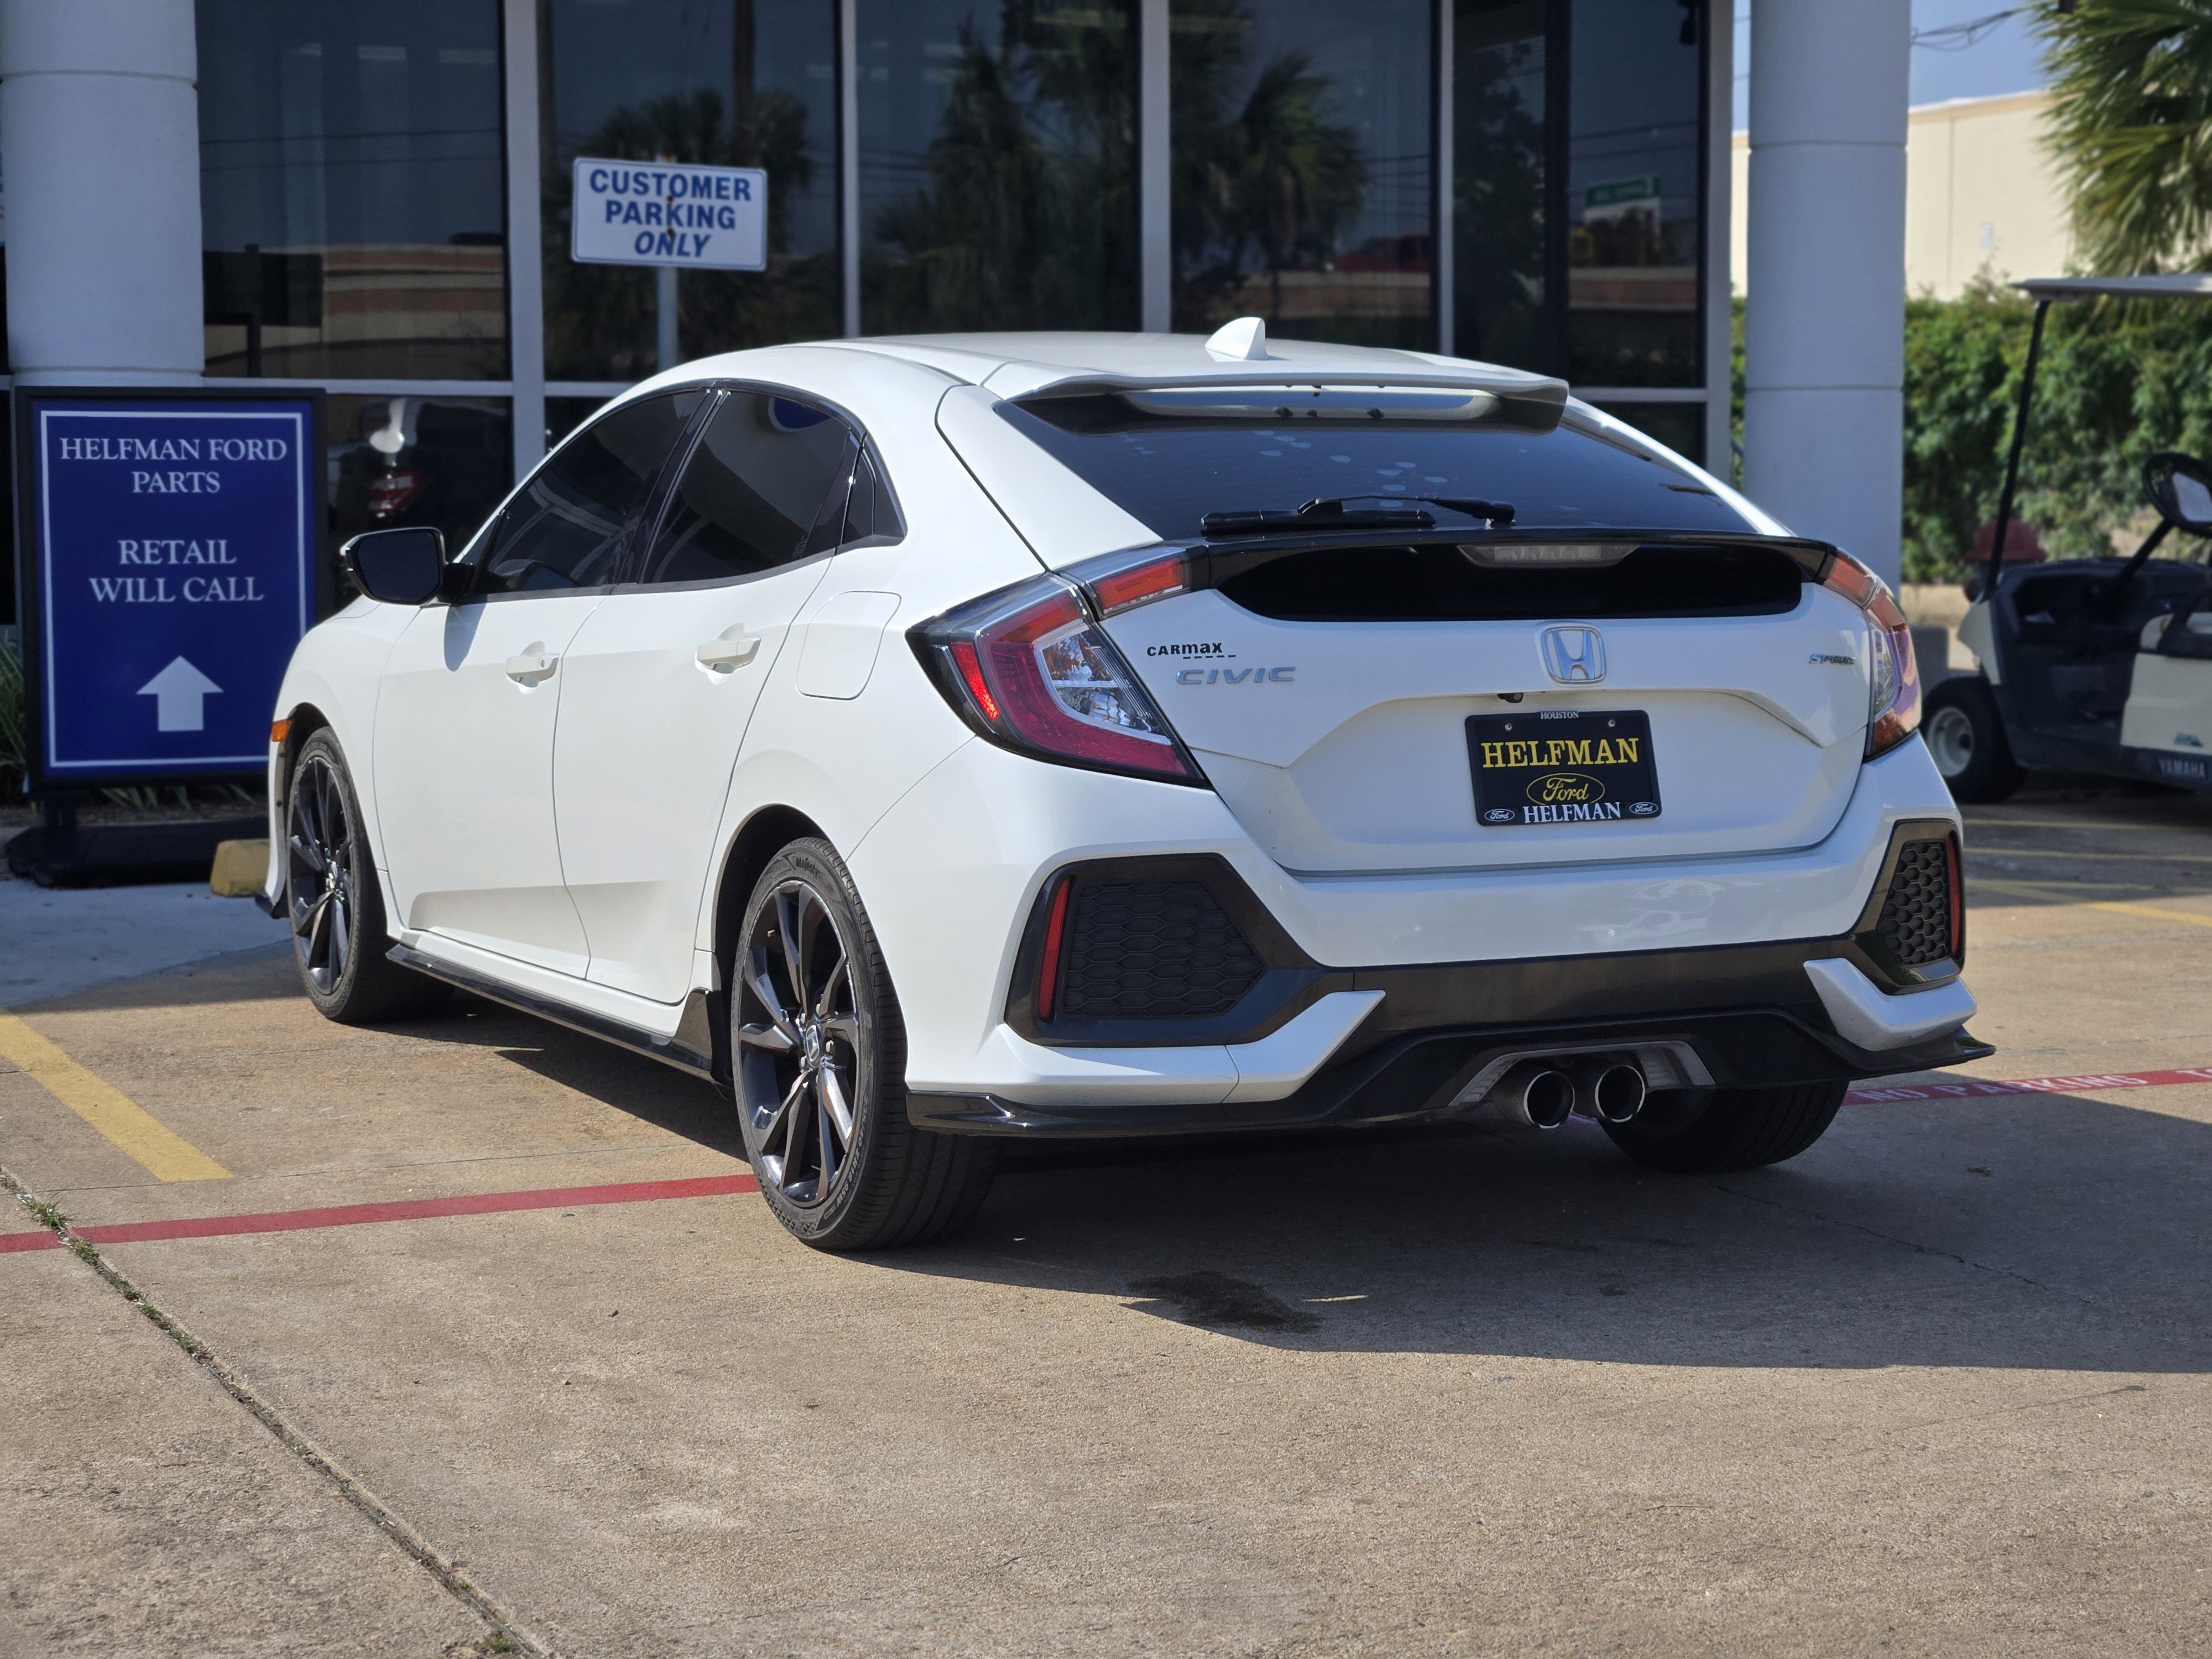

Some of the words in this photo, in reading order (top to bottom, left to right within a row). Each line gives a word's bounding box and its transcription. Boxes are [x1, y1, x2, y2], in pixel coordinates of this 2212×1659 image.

[589, 169, 751, 201] CUSTOMER
[606, 200, 735, 229] PARKING
[634, 231, 711, 257] ONLY
[60, 437, 200, 461] HELFMAN
[208, 439, 287, 461] FORD
[132, 471, 221, 493] PARTS
[118, 539, 237, 565] RETAIL
[88, 578, 175, 602] WILL
[183, 577, 264, 602] CALL
[1176, 666, 1296, 685] CIVIC
[1540, 711, 1579, 719] HOUSTON
[1480, 738, 1639, 768] HELFMAN
[1543, 777, 1589, 801] Ford
[1490, 811, 1509, 820] Ford
[1522, 802, 1621, 823] HELFMAN
[1635, 803, 1653, 813] Ford
[1853, 1088, 1929, 1100] NO
[1933, 1076, 2147, 1095] PARKING
[2176, 1068, 2212, 1078] T
